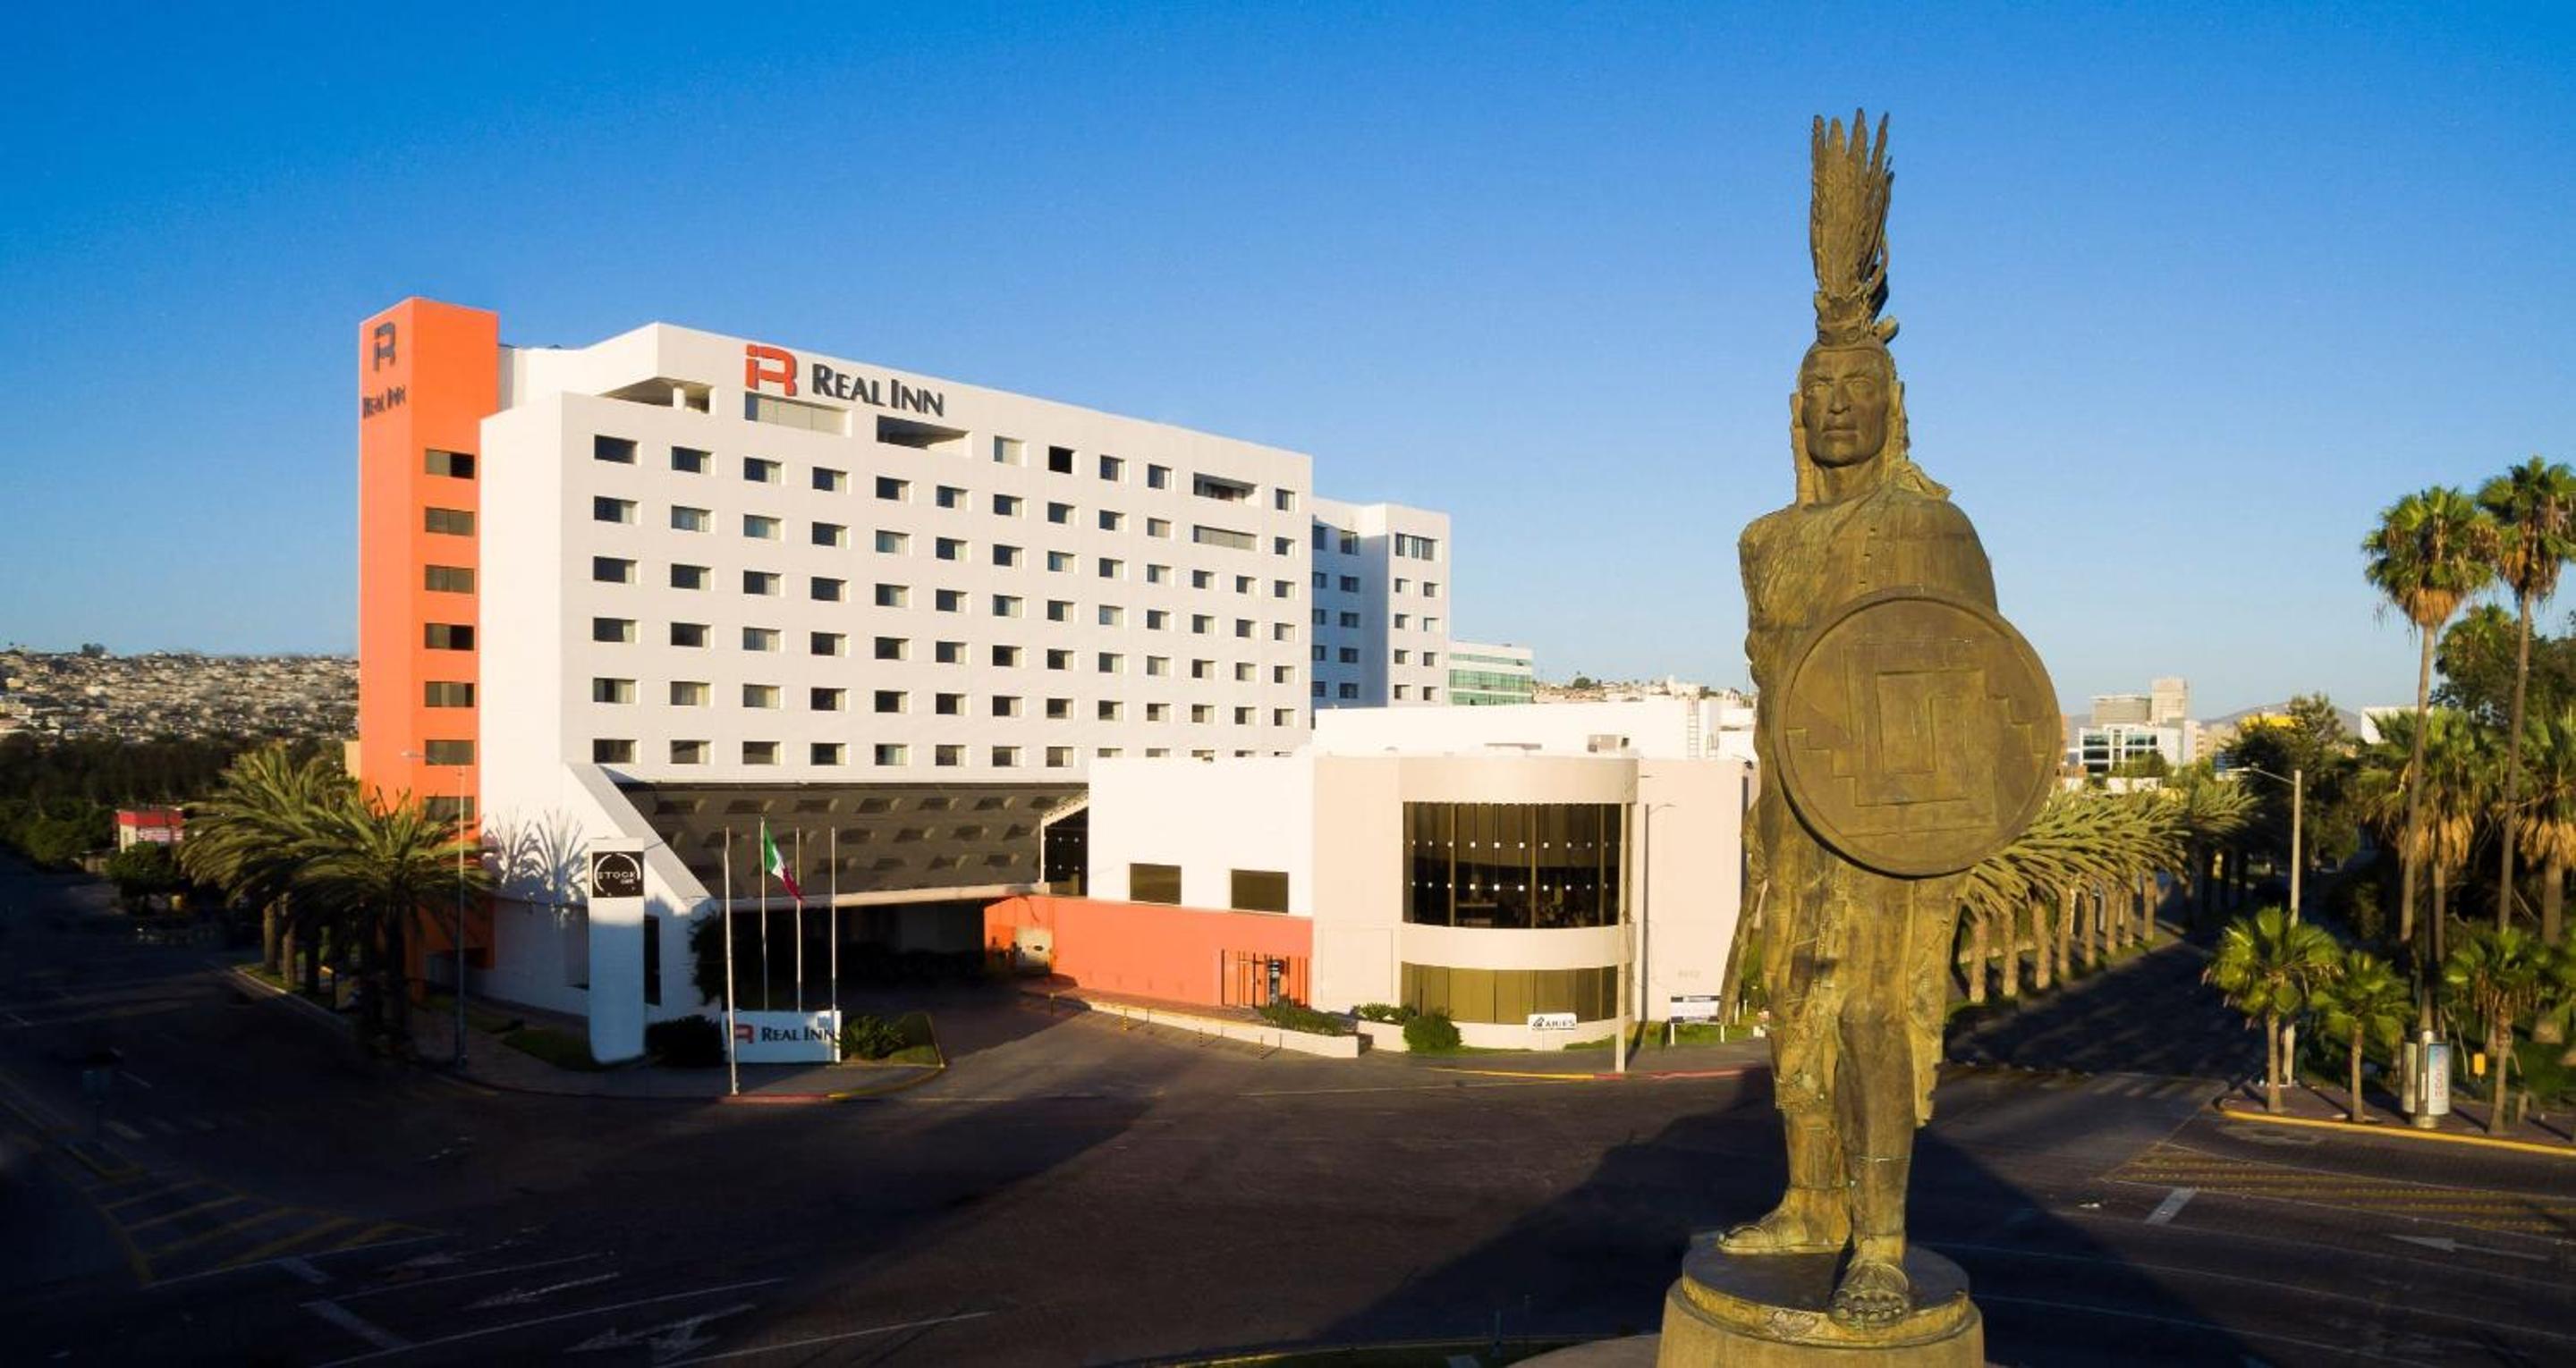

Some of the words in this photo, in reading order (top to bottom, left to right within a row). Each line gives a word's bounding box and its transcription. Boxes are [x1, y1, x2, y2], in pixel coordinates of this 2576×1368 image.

[812, 363, 886, 407] REAL
[891, 378, 944, 417] INN
[761, 1026, 798, 1042] REAL
